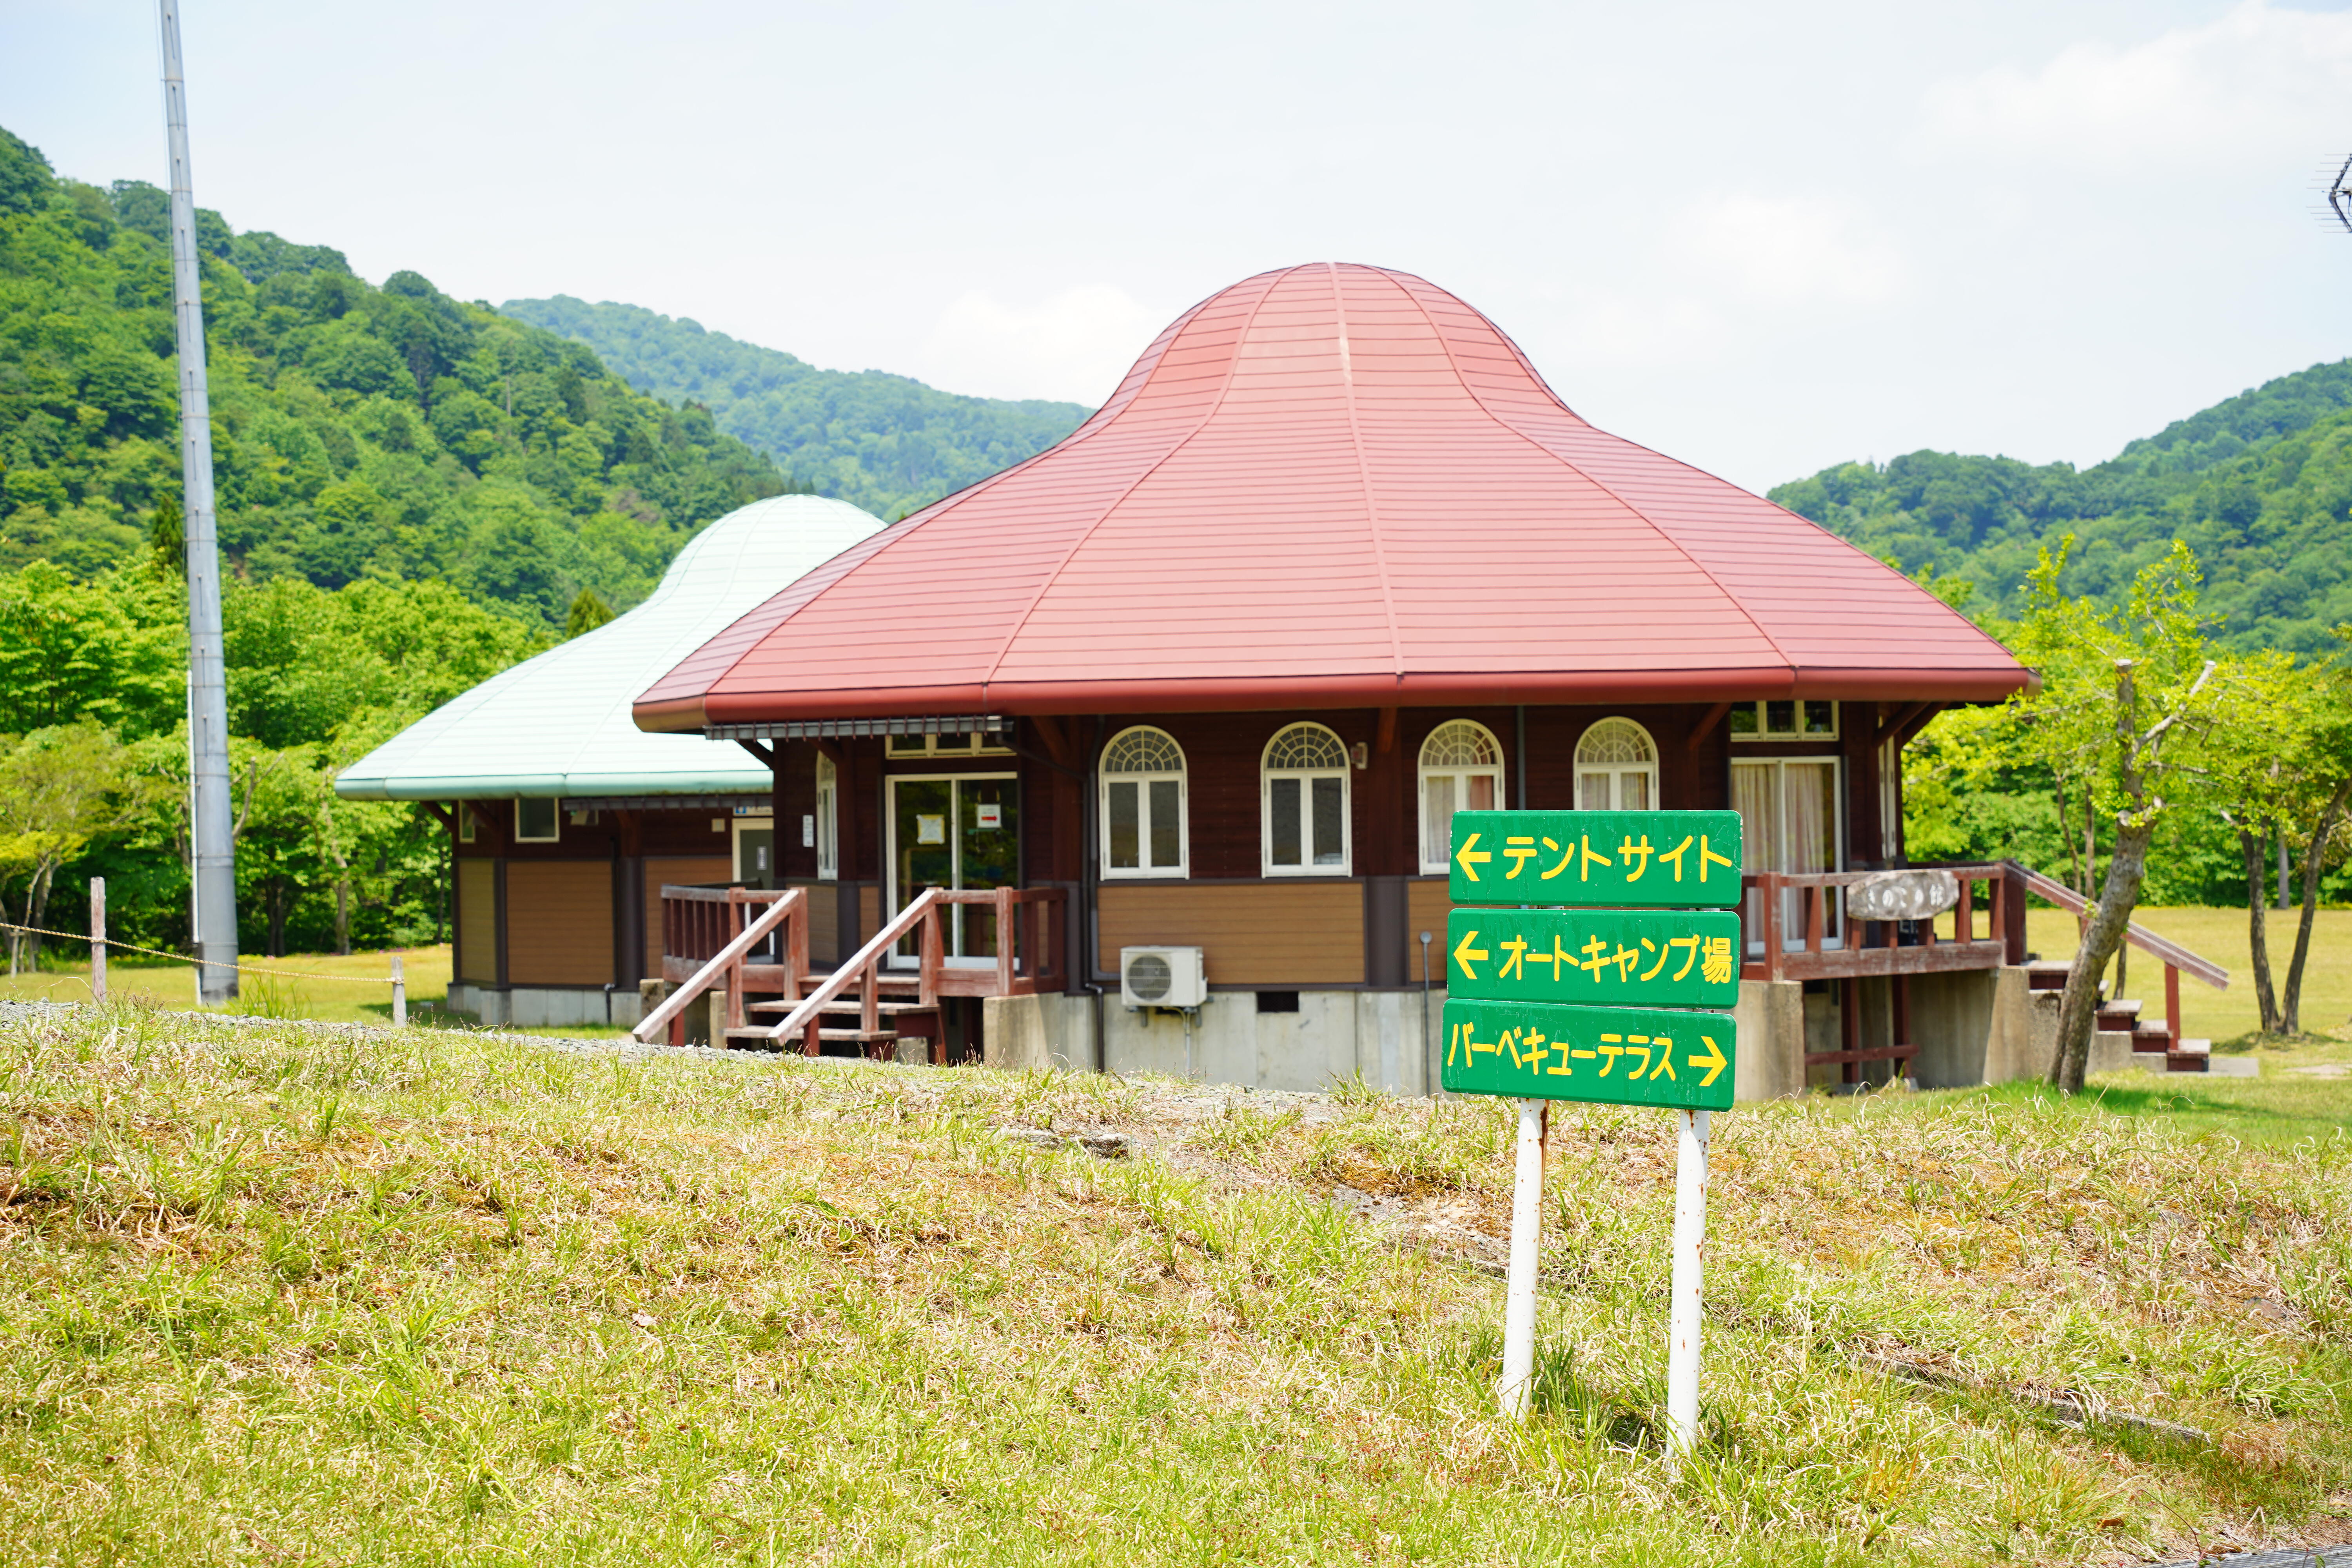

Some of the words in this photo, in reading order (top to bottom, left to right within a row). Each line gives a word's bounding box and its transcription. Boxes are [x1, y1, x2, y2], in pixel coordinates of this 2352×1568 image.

[1504, 835, 1732, 882] テントサイト
[1499, 935, 1733, 984] オートキャンプ場
[1448, 1022, 1676, 1080] バーベキューテラス
